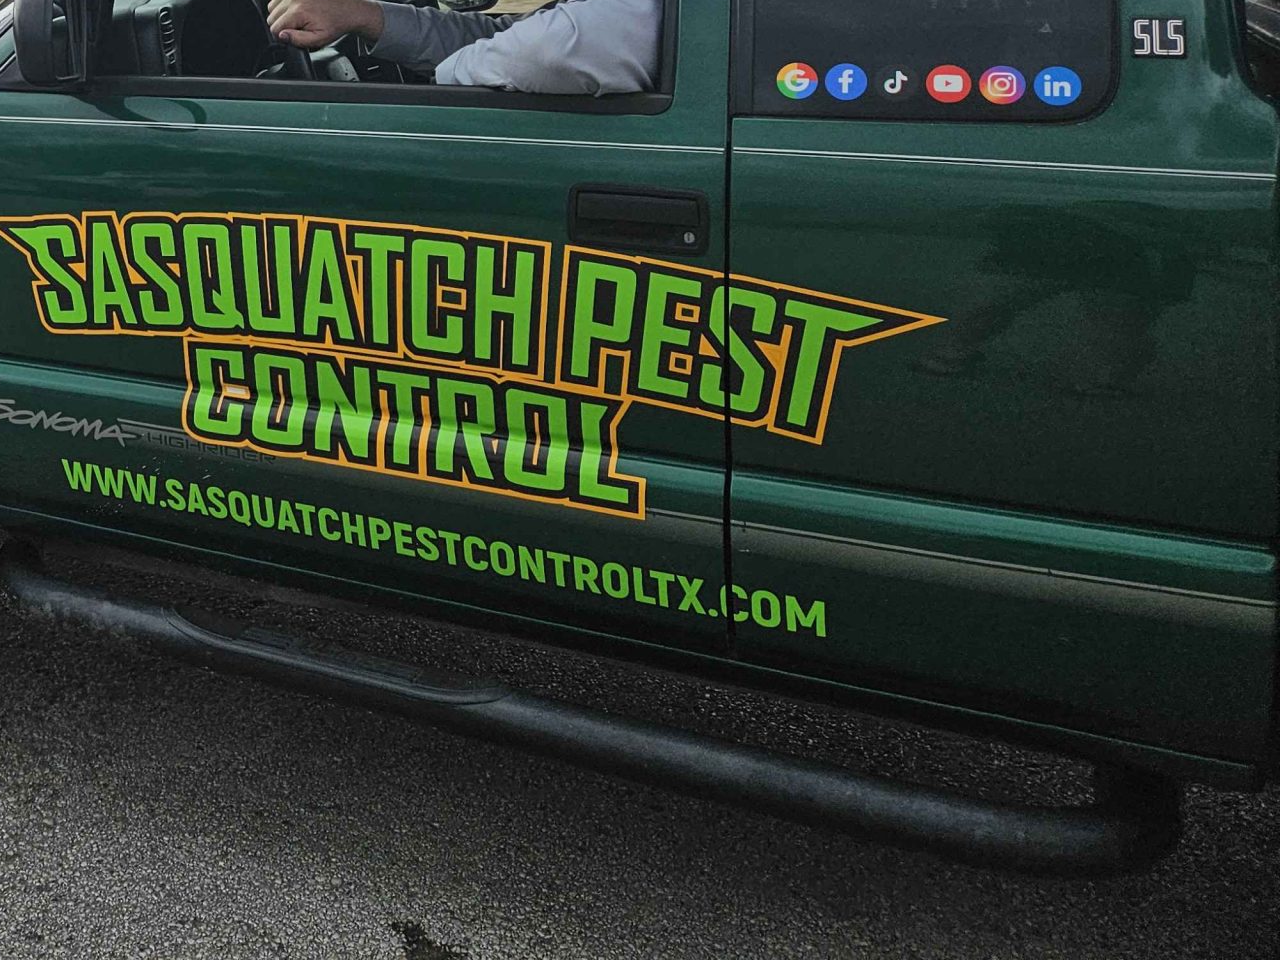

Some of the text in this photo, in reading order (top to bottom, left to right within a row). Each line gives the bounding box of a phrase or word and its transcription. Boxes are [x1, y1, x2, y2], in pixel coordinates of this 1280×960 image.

[1133, 19, 1185, 56] SLS
[24, 223, 888, 430] SASQUATCH PEST
[192, 348, 631, 506] CONTROL
[61, 458, 827, 638] WWW.SASQUATCHPESTCONTROLTX.COM
